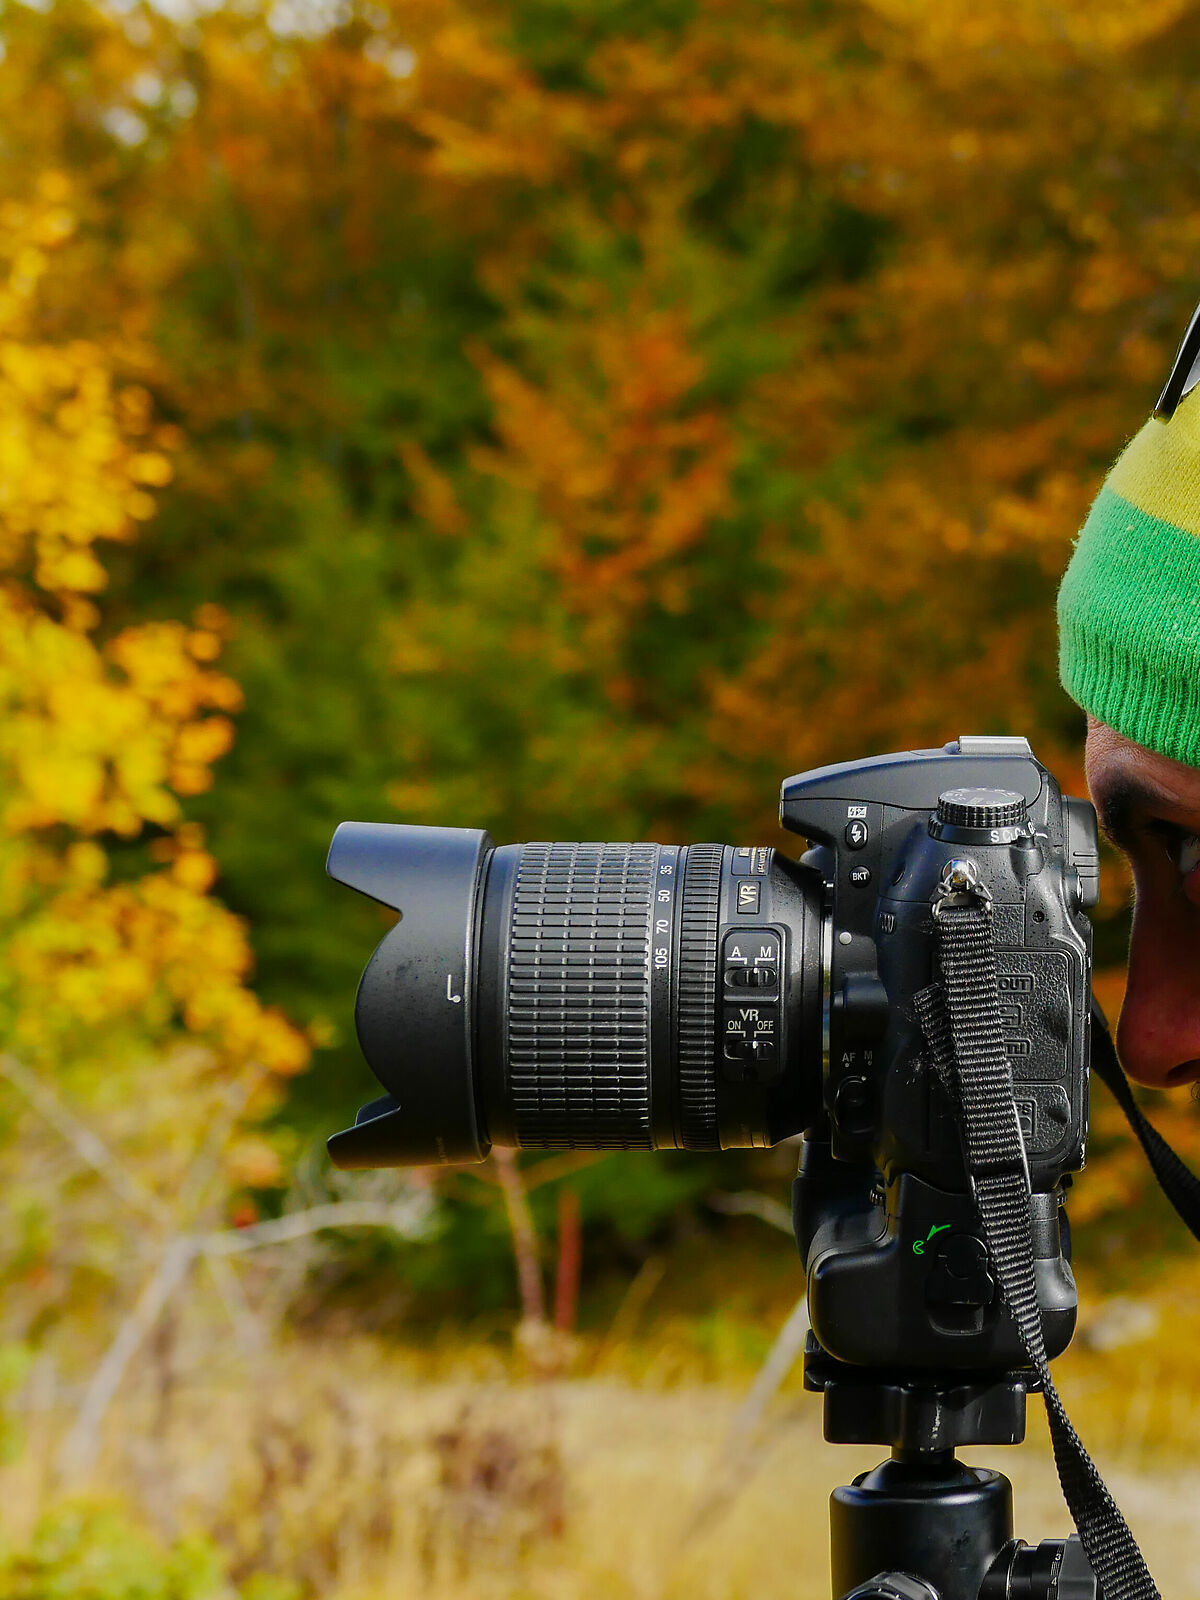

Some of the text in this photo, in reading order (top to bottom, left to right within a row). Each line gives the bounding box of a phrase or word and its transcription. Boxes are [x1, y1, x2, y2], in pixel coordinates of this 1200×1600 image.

[660, 864, 673, 876] 35
[852, 871, 868, 881] BKT
[658, 889, 671, 903] 50
[739, 885, 757, 907] VR
[656, 919, 669, 935] 70
[731, 945, 741, 958] A
[760, 945, 772, 958] M
[654, 947, 668, 970] 105
[998, 978, 1030, 991] OUT
[739, 1008, 759, 1022] VR
[727, 1020, 742, 1030] ON
[757, 1020, 774, 1031] OFF
[842, 1052, 856, 1062] AF
[864, 1050, 873, 1060] M
